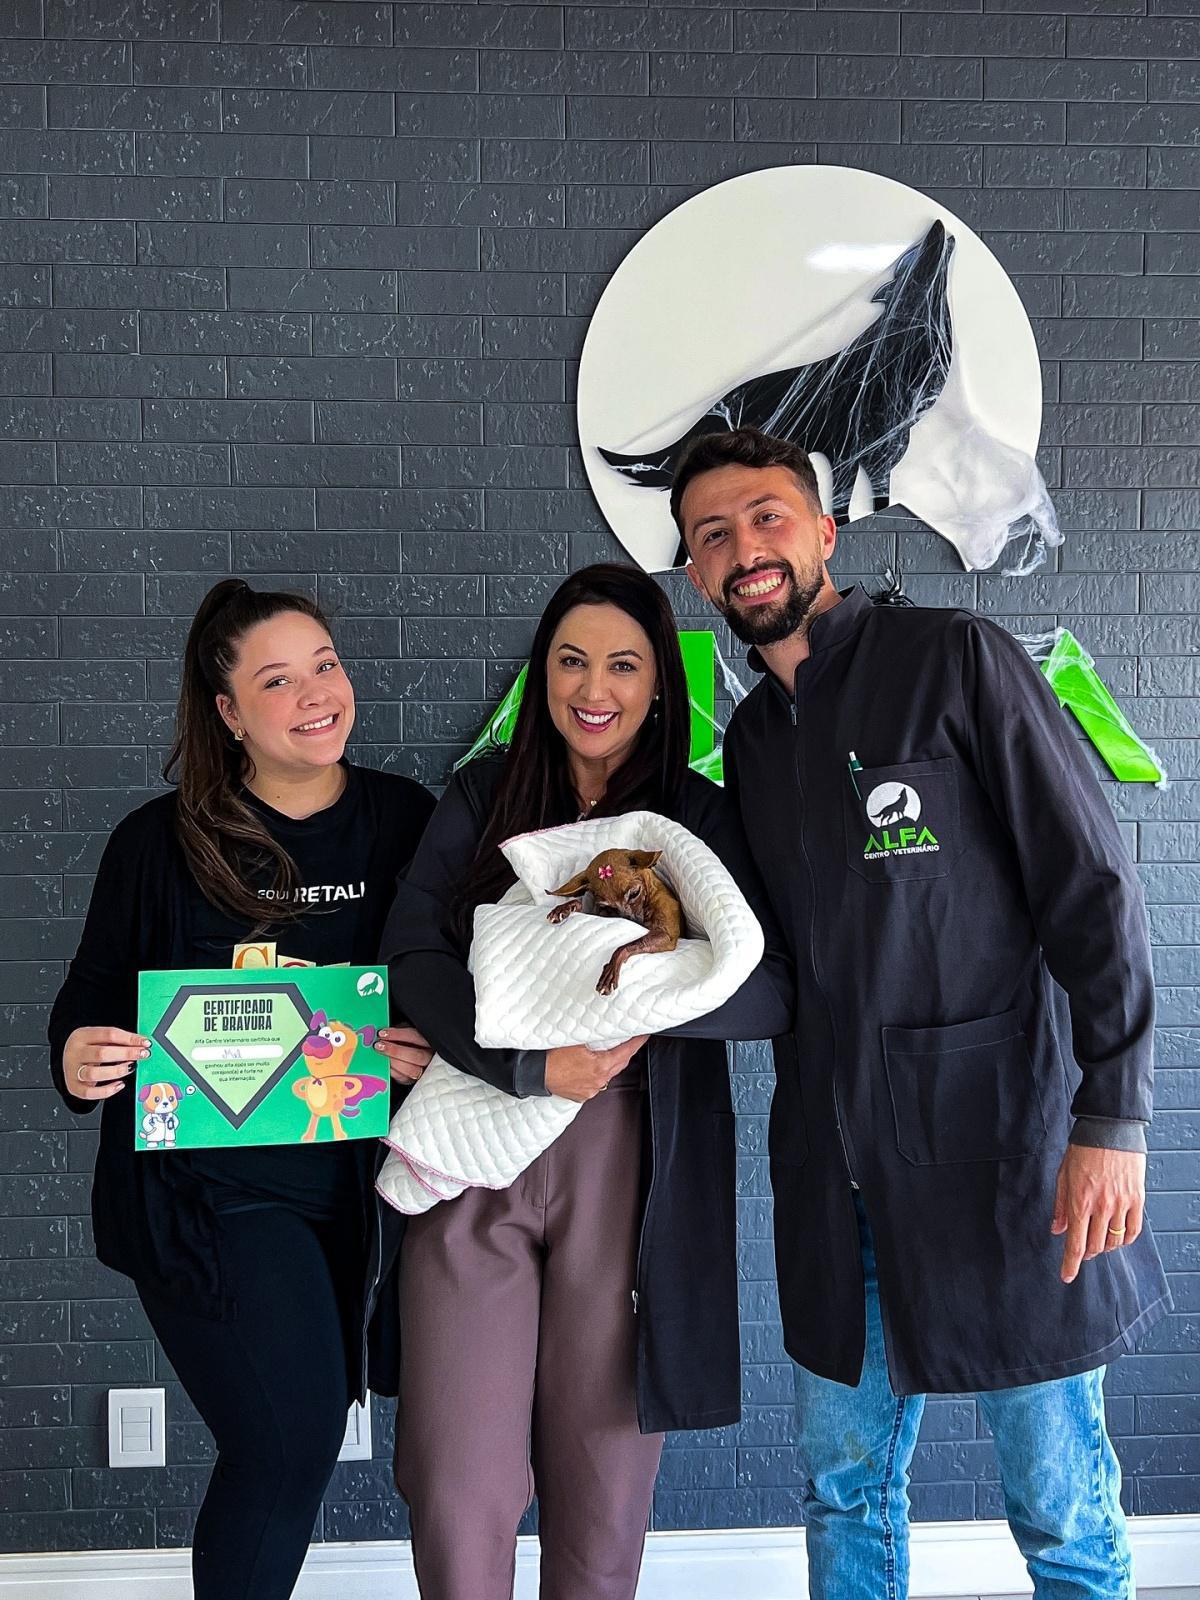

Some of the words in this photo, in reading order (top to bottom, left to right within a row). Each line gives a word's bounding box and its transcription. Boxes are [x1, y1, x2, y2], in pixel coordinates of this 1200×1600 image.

[864, 826, 938, 852] ALFA
[864, 850, 890, 860] CENTRO
[893, 843, 940, 855] VETERINÁRIO
[203, 999, 273, 1015] CERTIFICADO
[204, 1016, 218, 1031] DE
[222, 1015, 272, 1031] BRAVURA
